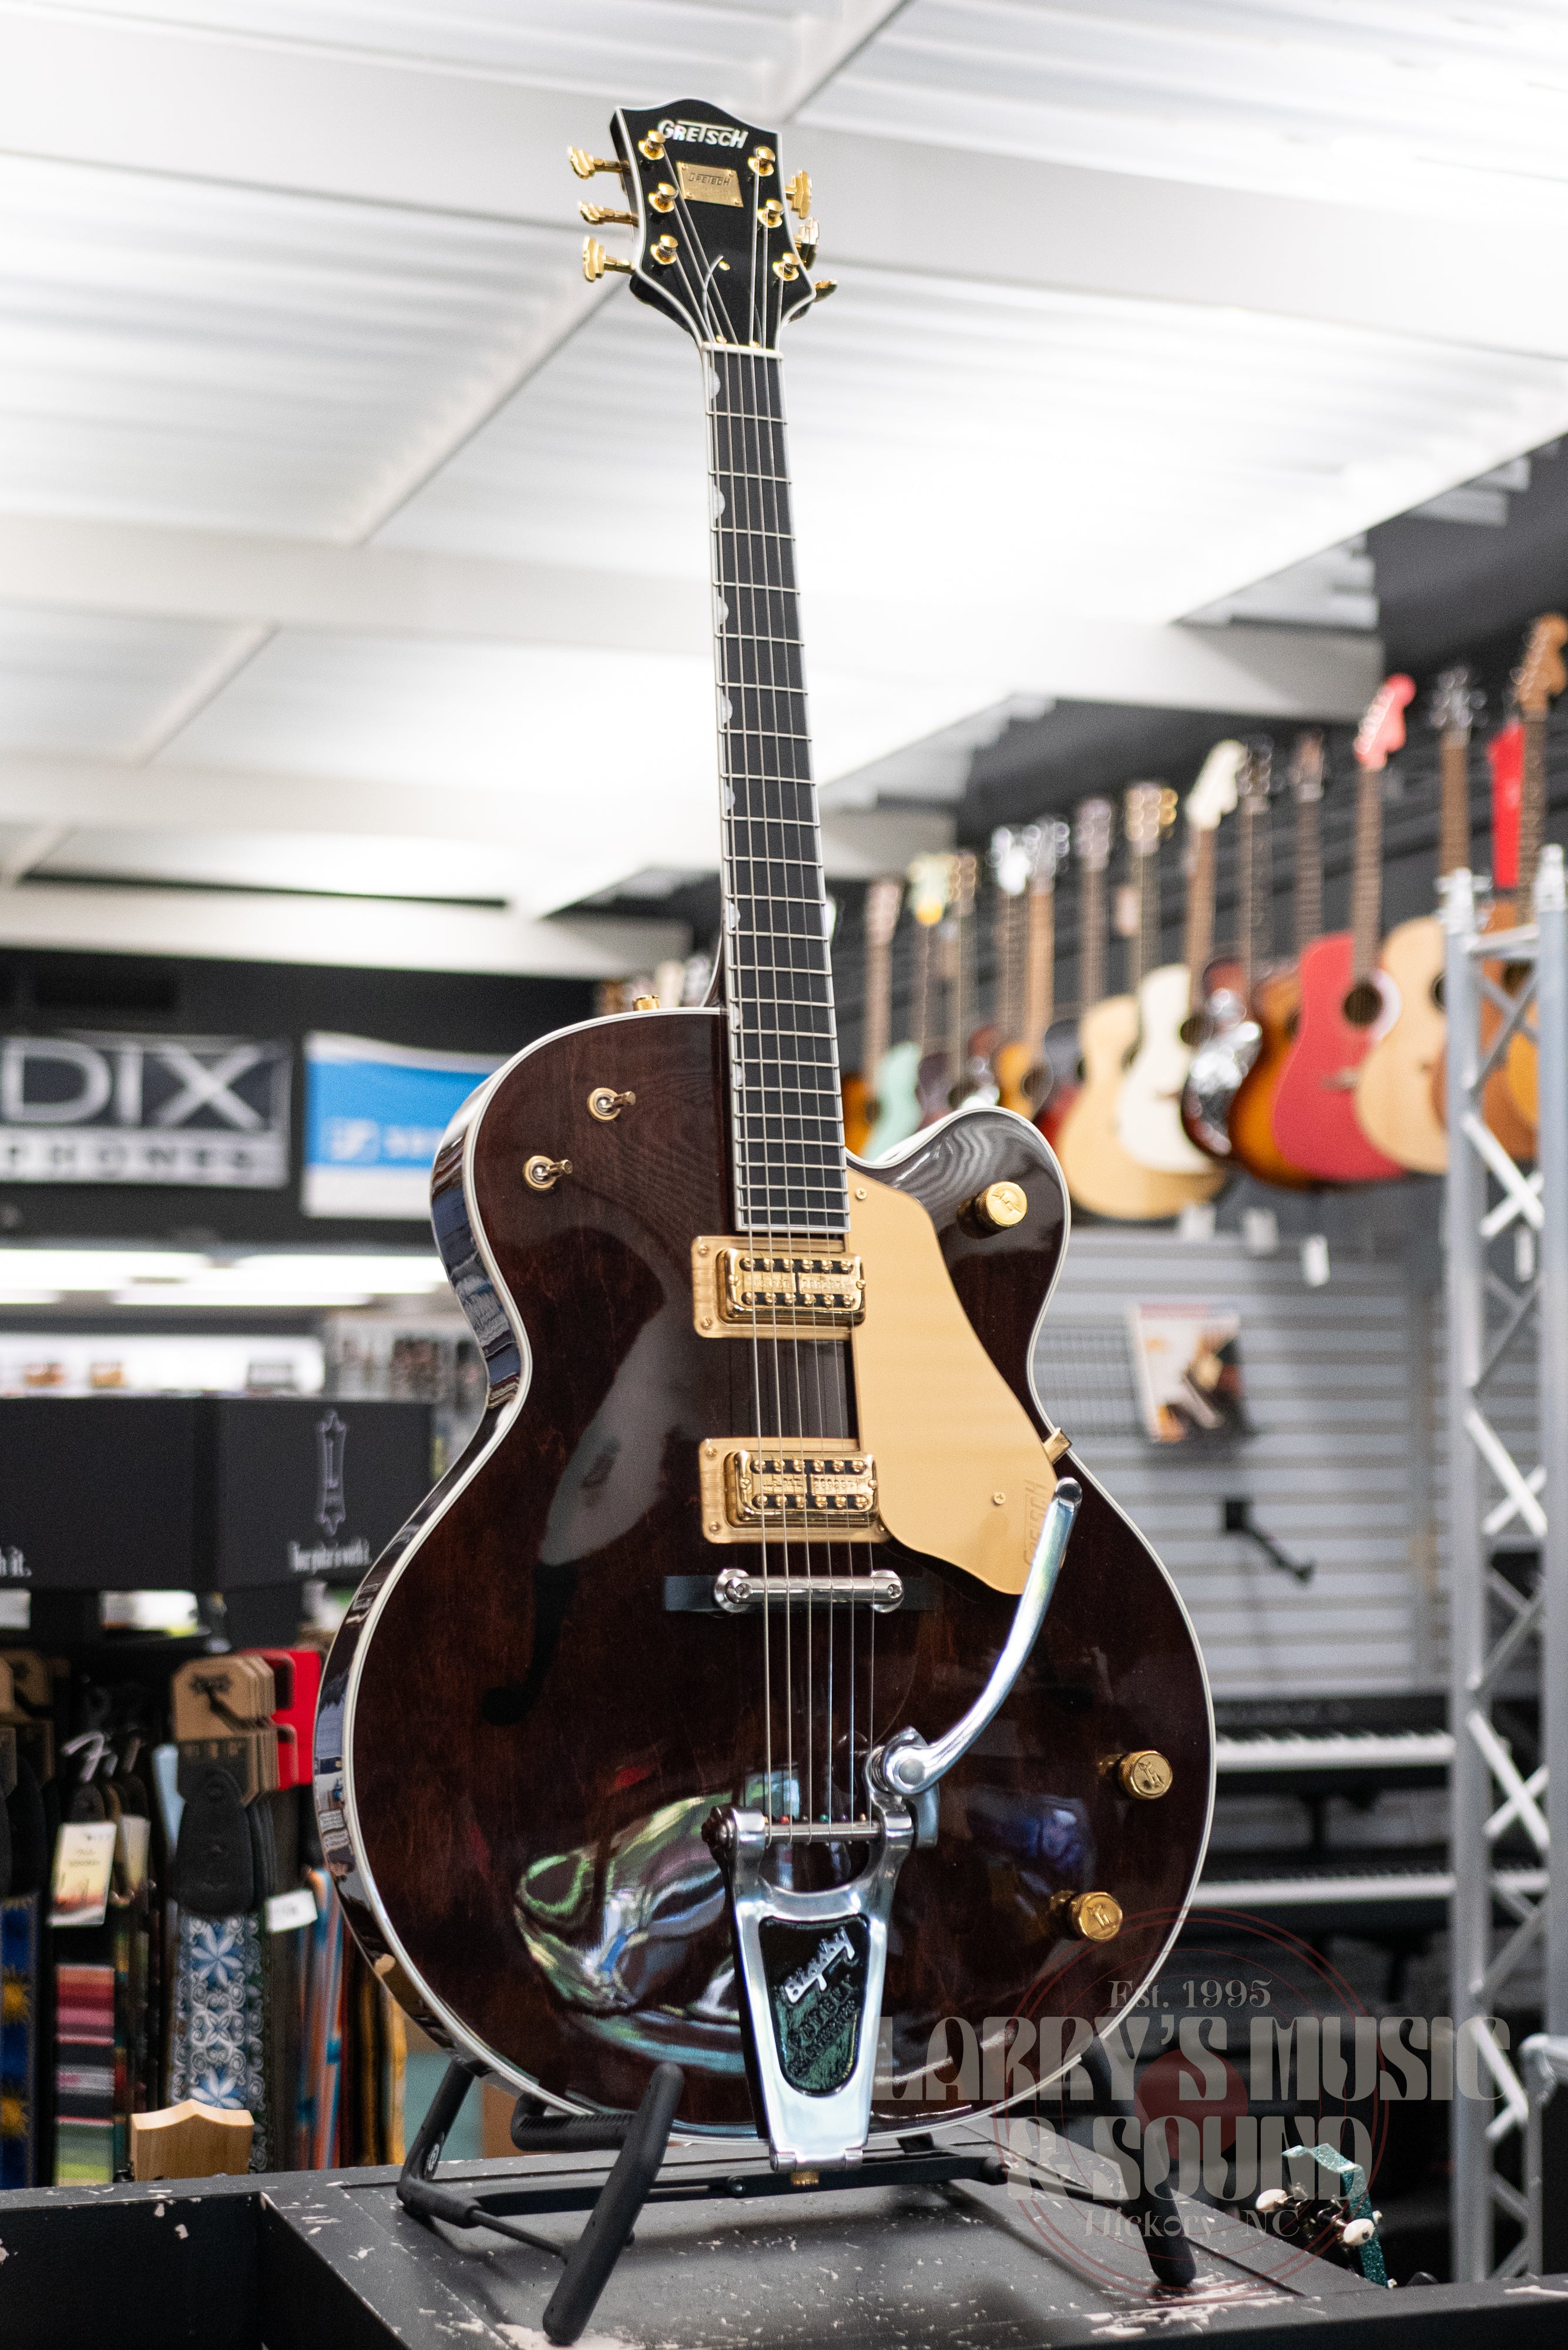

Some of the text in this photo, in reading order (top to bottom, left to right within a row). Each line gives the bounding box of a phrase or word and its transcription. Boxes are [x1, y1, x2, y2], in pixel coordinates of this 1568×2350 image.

[657, 119, 749, 149] GRETSCH
[688, 172, 731, 186] GRETSCH
[2, 1036, 264, 1129] DIX
[784, 1926, 855, 2003] Bigsby
